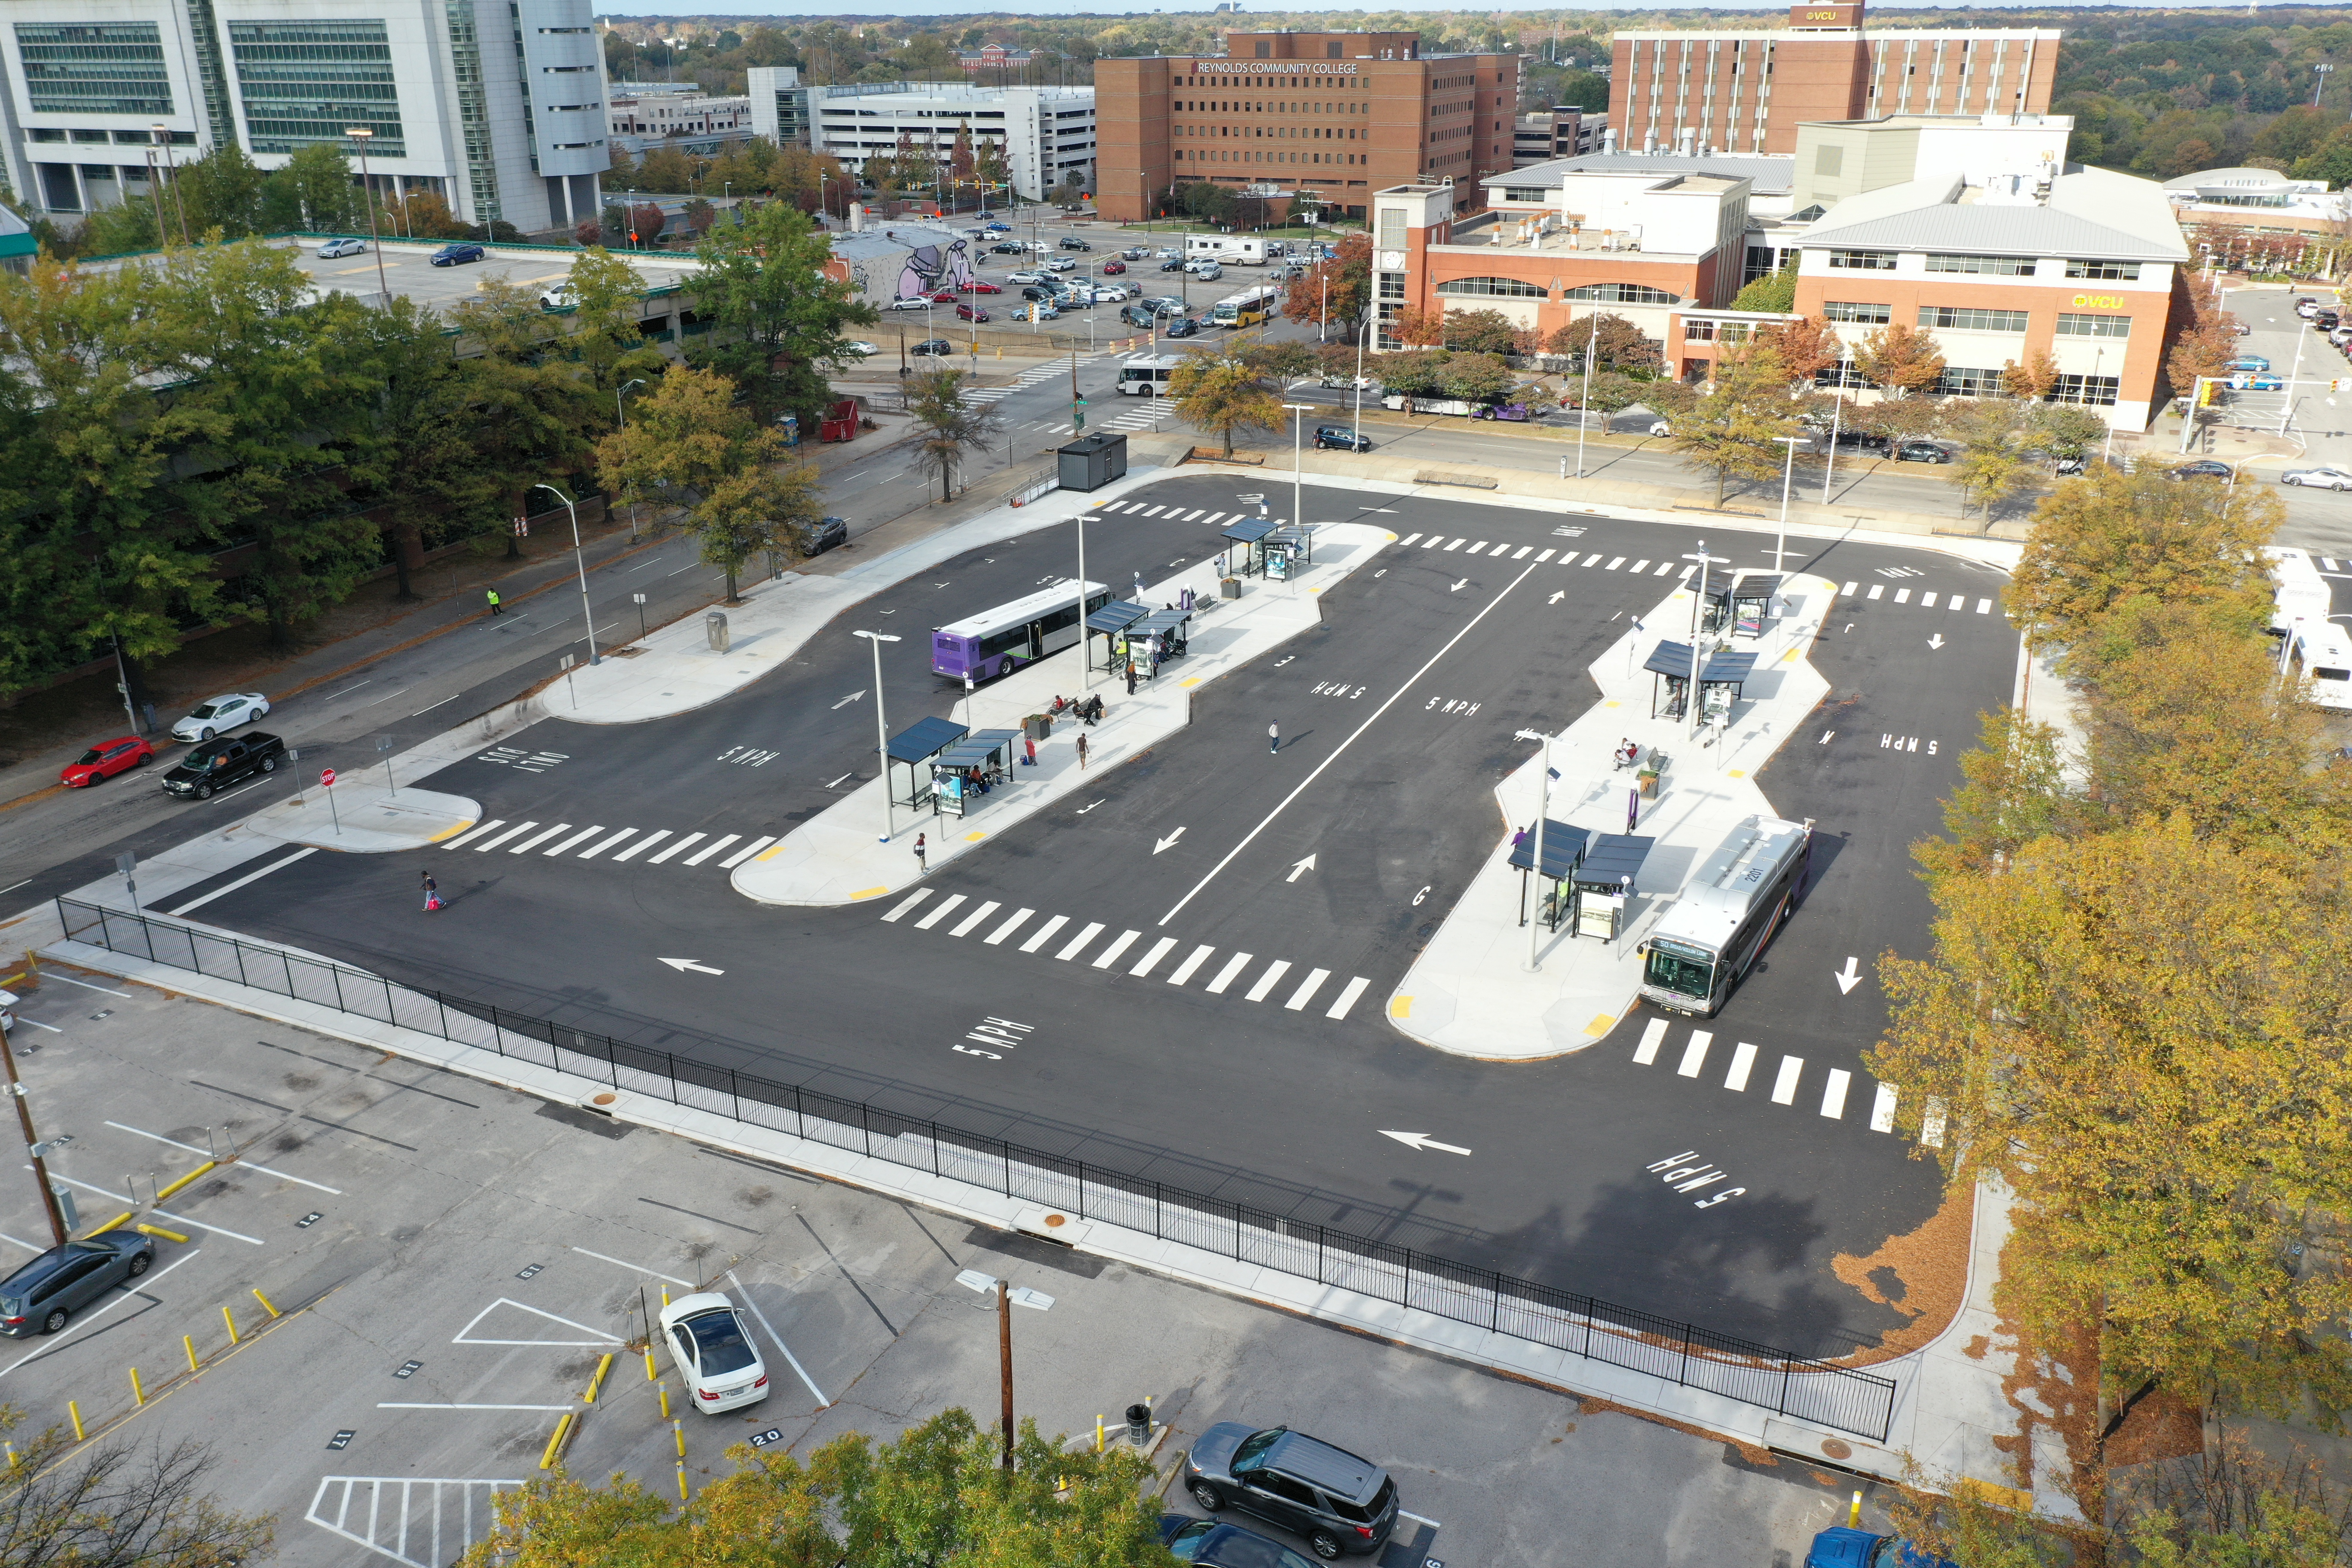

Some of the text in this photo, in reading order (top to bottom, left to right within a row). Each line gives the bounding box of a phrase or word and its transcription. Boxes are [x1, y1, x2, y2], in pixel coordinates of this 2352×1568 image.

[1814, 12, 1836, 20] VCU
[1198, 63, 1357, 74] REYNOLDS COMMUNITY COLLEGE
[2088, 296, 2124, 309] VCU
[1310, 681, 1366, 699] 5 MPH
[1425, 697, 1481, 717] 5 MPH
[1880, 733, 1938, 755] 5 MPH
[478, 747, 528, 763] BUS
[512, 752, 570, 773] ONLY
[717, 746, 780, 767] 5 MPH
[322, 773, 334, 783] STOP
[1745, 867, 1764, 882] 2201
[1412, 886, 1431, 906] G
[1660, 940, 1669, 948] 50
[952, 1017, 1035, 1060] 5 MPH
[1646, 1151, 1746, 1209] 5 MPH
[300, 1214, 319, 1225] 14
[398, 1363, 419, 1376] 18
[332, 1433, 351, 1447] 17
[753, 1431, 779, 1446] 20
